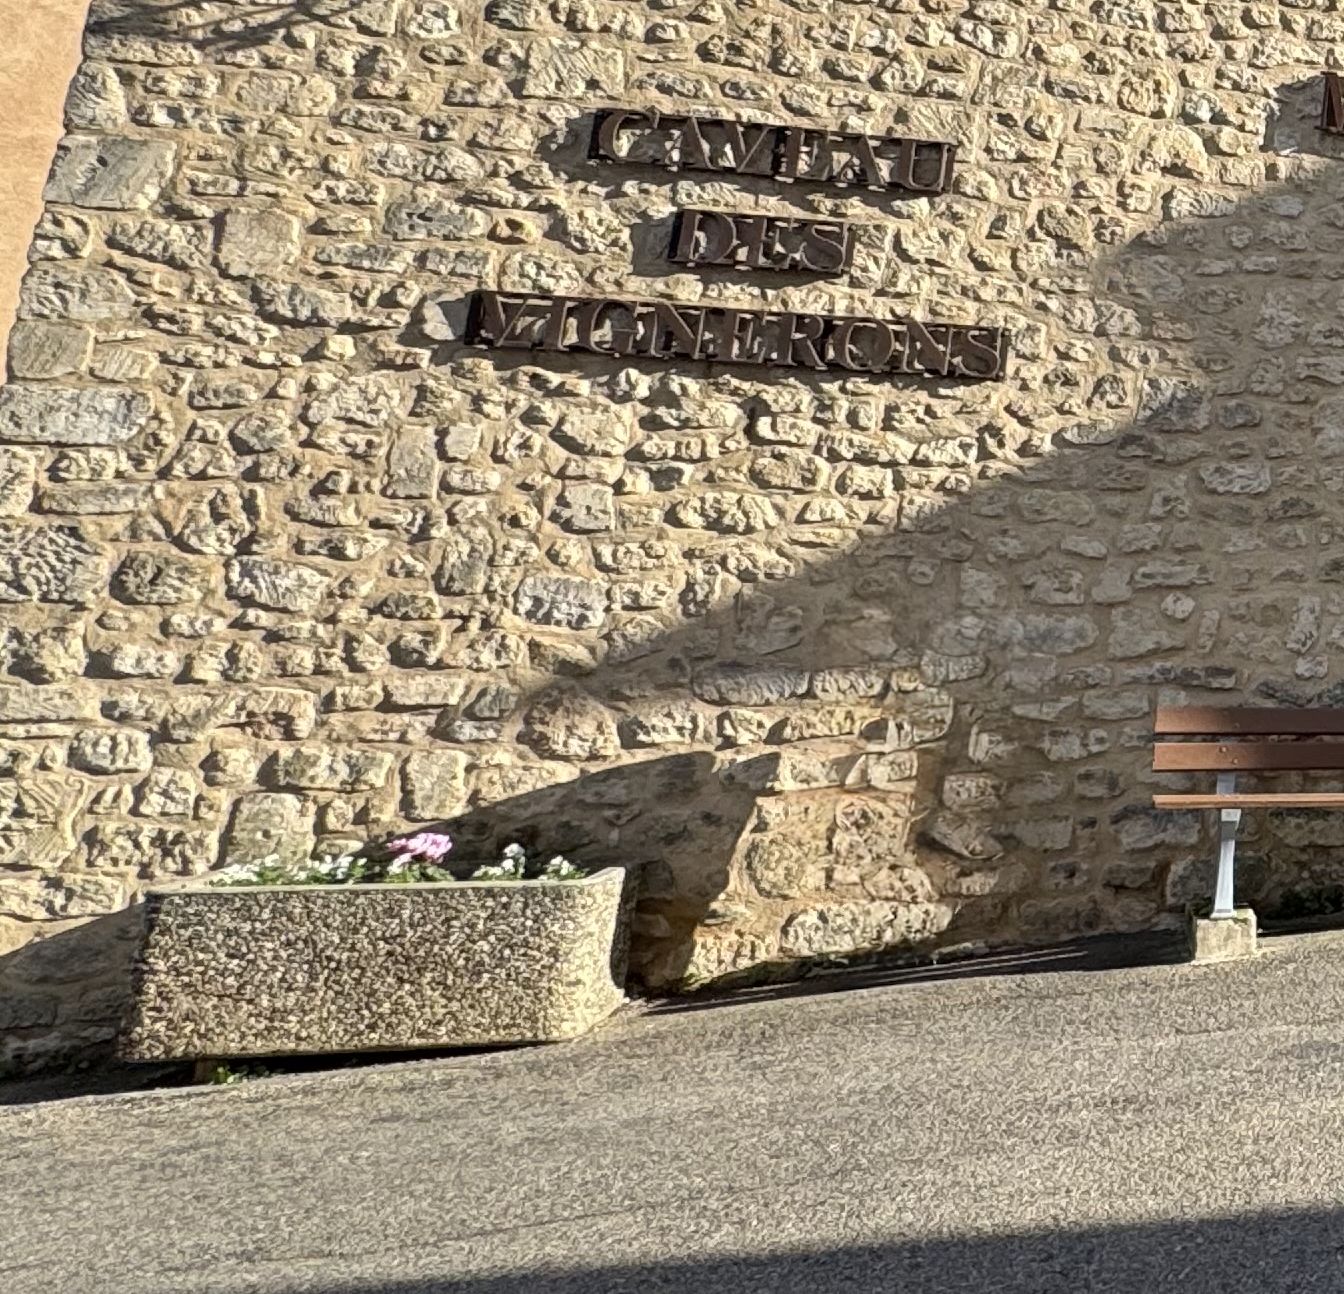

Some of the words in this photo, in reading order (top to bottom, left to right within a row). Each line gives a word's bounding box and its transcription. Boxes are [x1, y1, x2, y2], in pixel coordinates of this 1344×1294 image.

[590, 108, 957, 193] CAVEAU
[670, 208, 855, 275] DES
[472, 290, 1006, 380] VIGNERONS
